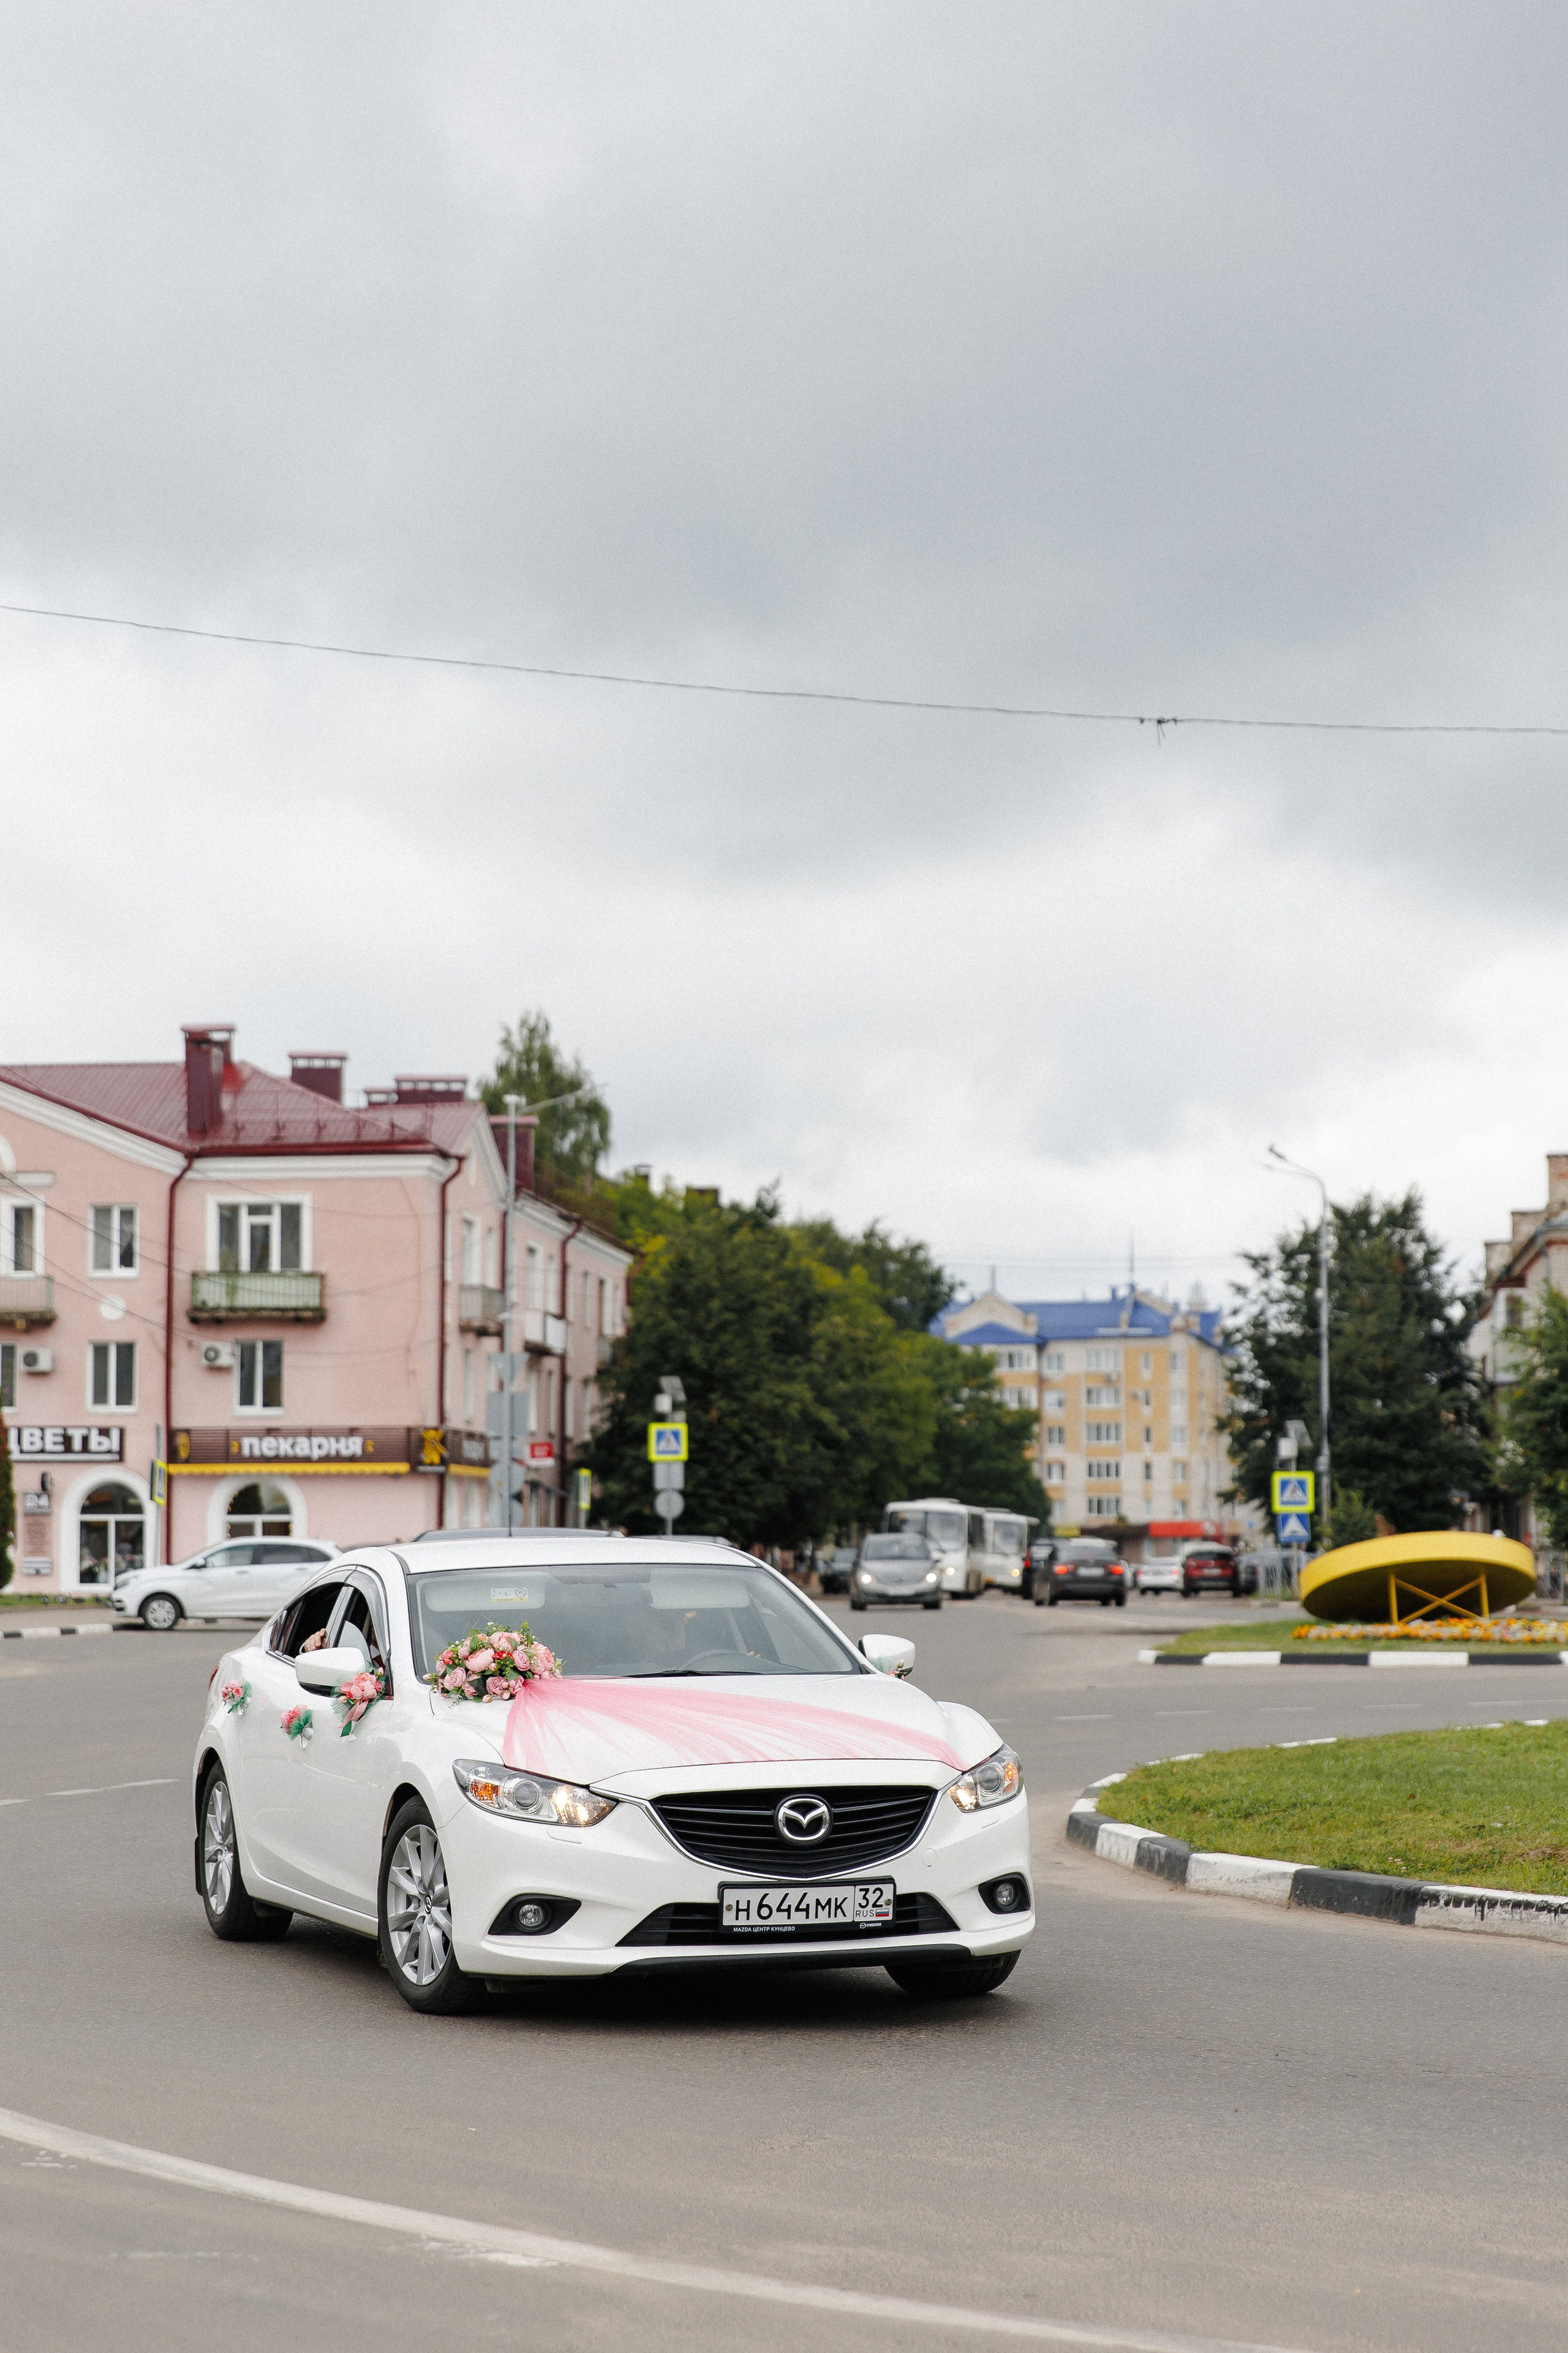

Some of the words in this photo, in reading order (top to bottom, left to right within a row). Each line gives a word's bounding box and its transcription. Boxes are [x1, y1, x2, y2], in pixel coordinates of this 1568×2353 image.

[241, 1436, 363, 1460] пекарня
[735, 1892, 848, 1921] Н644МК
[858, 1887, 883, 1908] 32
[856, 1909, 875, 1918] RUS
